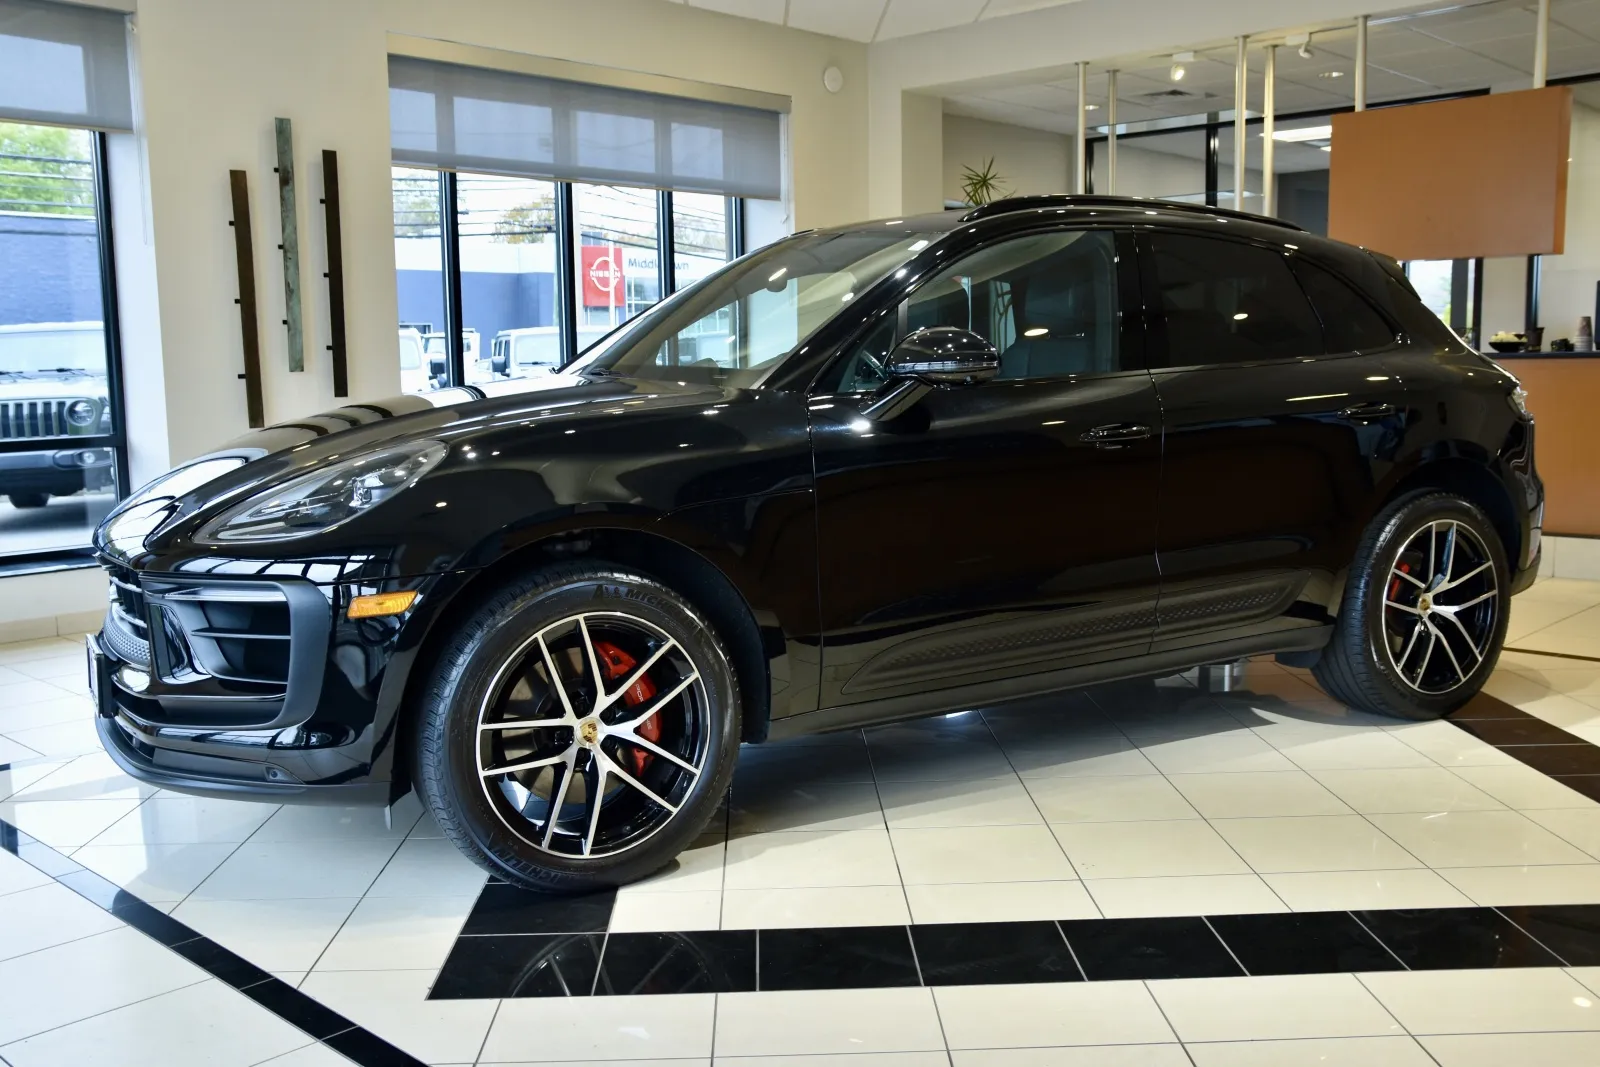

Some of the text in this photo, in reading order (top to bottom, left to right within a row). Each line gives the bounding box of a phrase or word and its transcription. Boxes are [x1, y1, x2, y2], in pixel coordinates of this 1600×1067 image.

[628, 258, 689, 271] Middlwn
[589, 269, 621, 278] NISSN
[489, 847, 568, 883] ICHELIN
